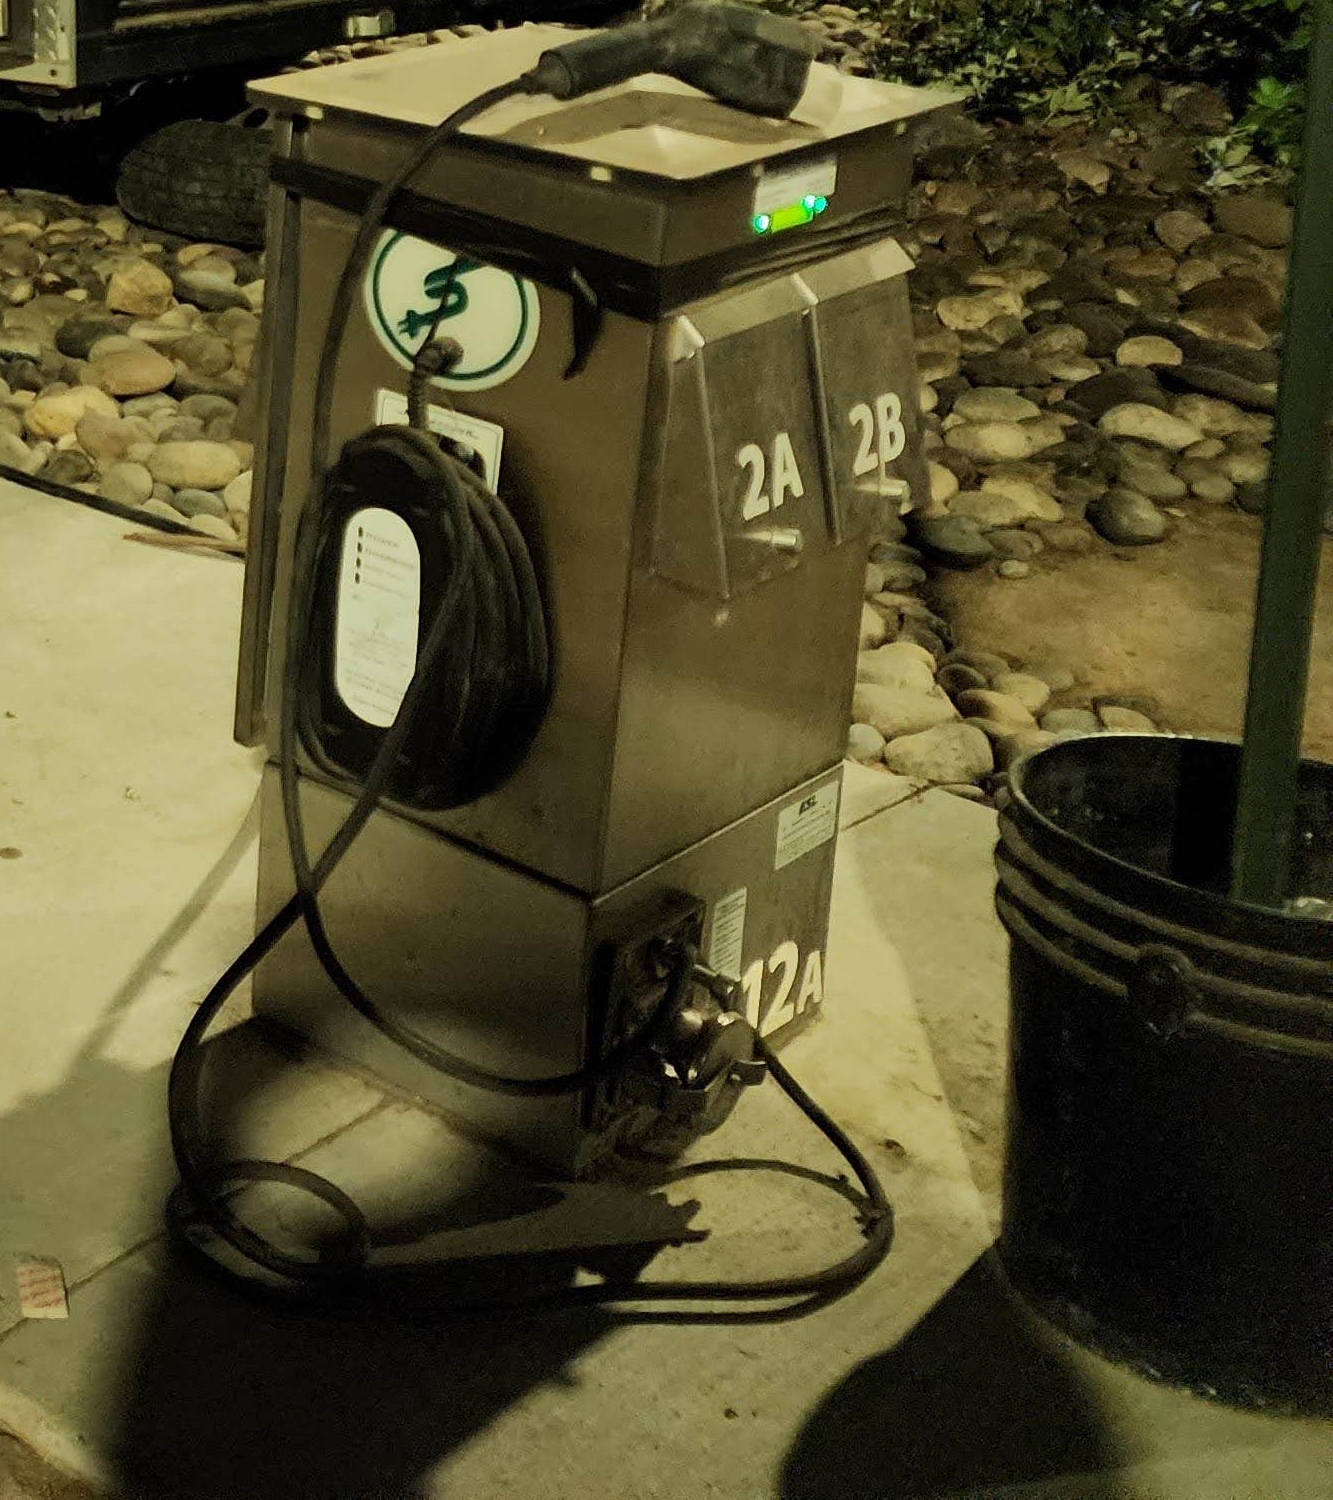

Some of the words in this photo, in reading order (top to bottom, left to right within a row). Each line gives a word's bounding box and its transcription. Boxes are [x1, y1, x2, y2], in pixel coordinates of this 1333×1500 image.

[738, 432, 804, 521] 2A
[848, 392, 906, 476] 2B
[742, 940, 823, 1038] 12A
